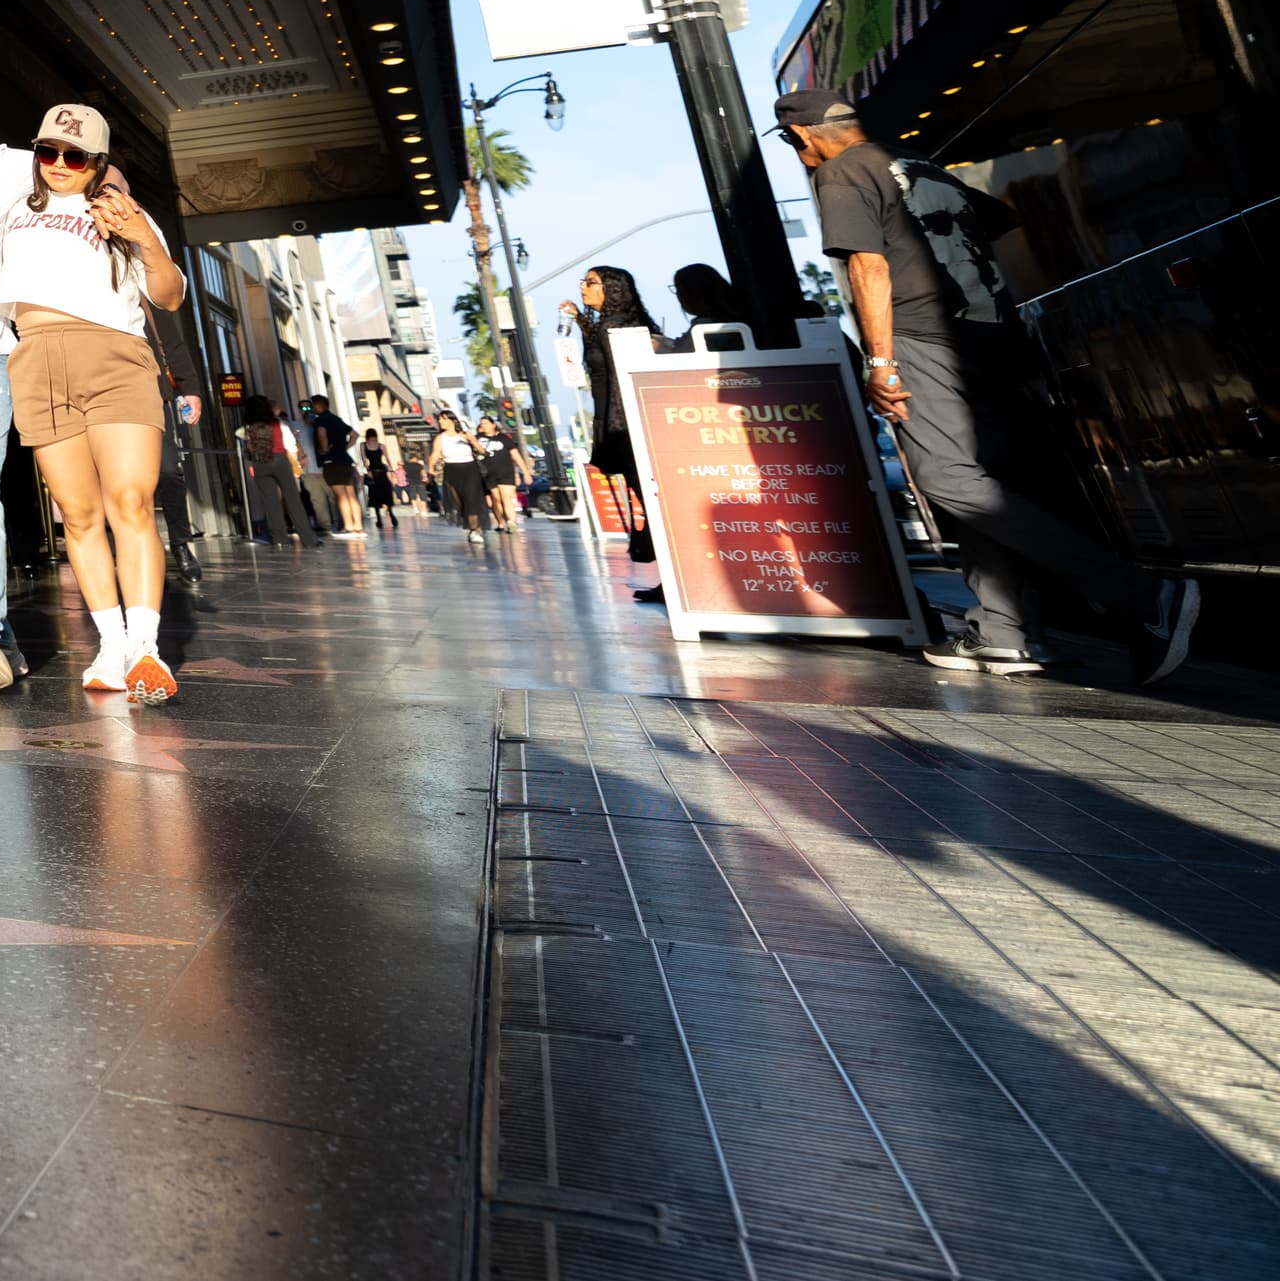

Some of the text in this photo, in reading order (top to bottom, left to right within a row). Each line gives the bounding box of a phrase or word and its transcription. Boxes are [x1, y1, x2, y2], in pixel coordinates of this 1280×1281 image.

[55, 109, 84, 138] CA
[664, 402, 824, 425] FOR QUICK
[699, 425, 798, 446] ENTRY:
[689, 463, 847, 477] HAVE TICKETS READY
[731, 477, 790, 491] BEFORE
[708, 492, 819, 506] SECURITY LINE
[713, 520, 853, 534] ENTER SINGLE FILE
[718, 549, 861, 565] NO BAGS LARGER
[756, 564, 805, 578] THAN
